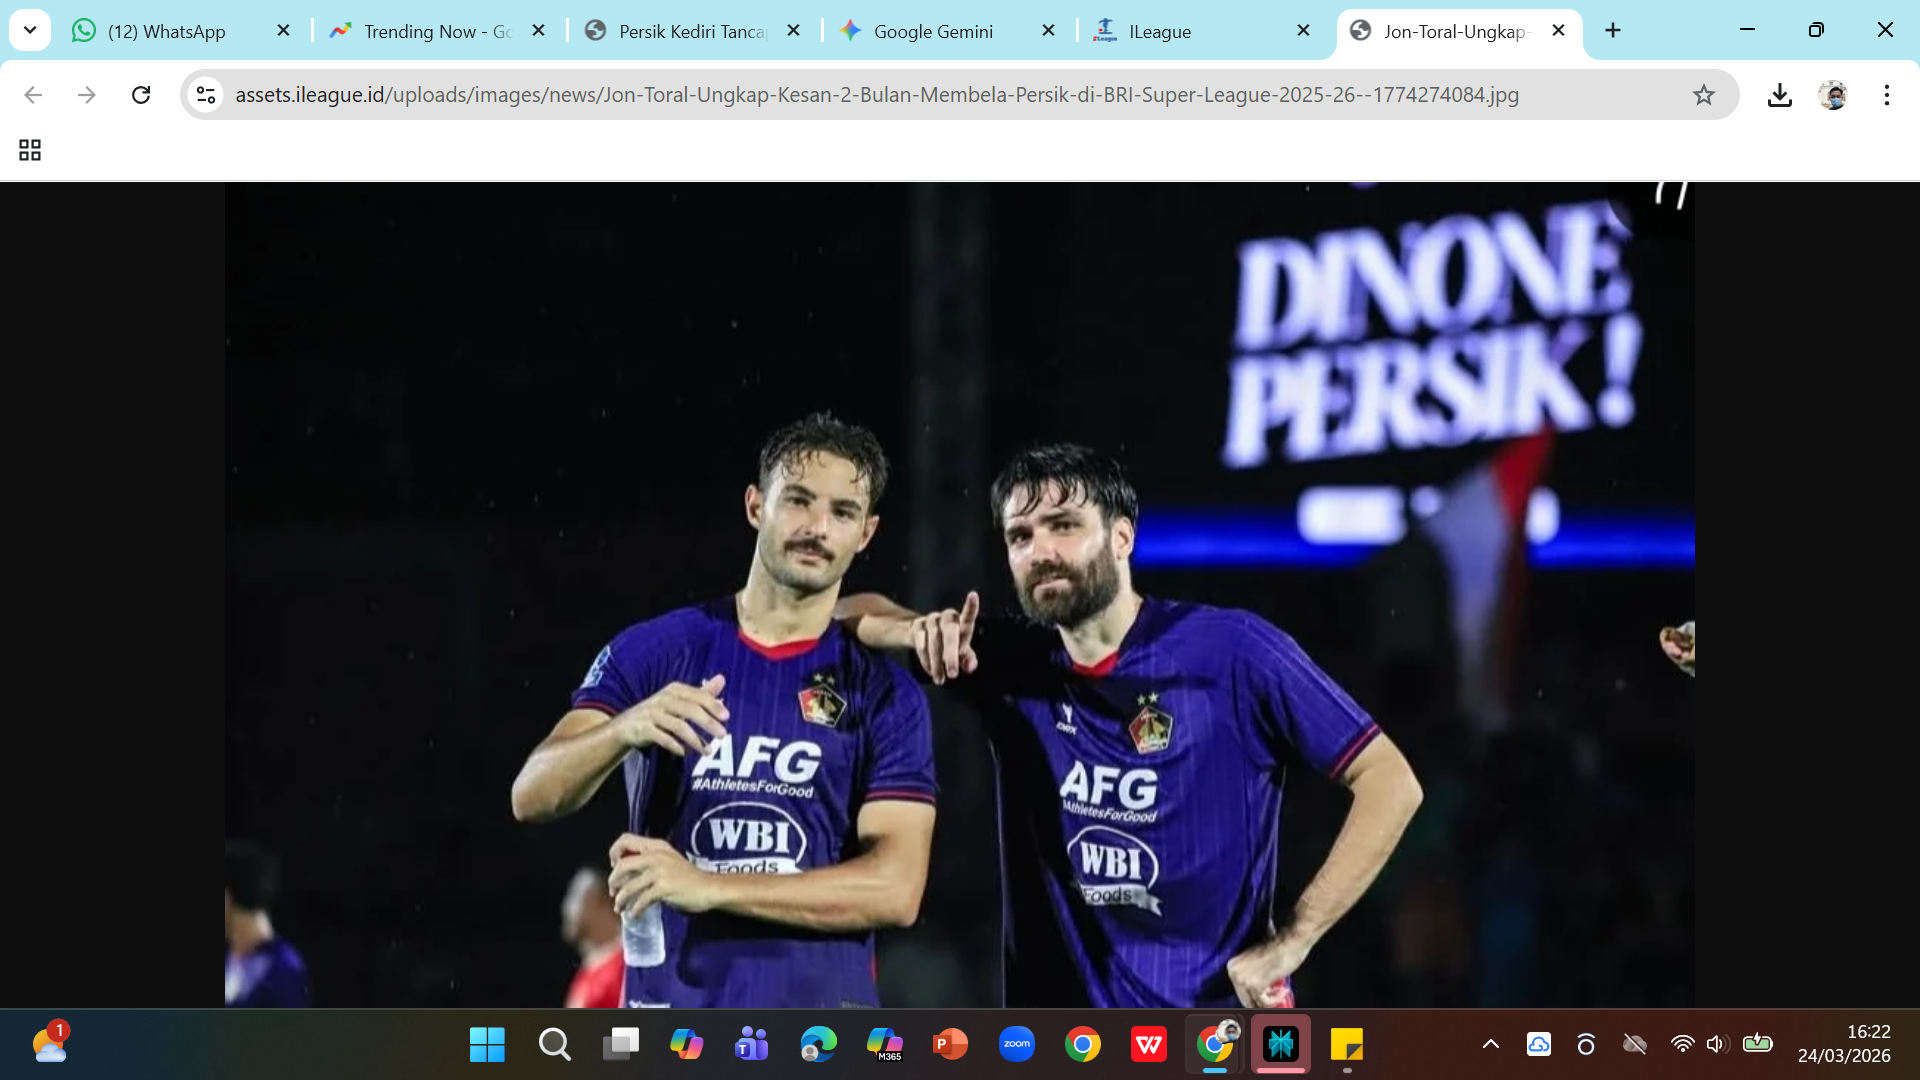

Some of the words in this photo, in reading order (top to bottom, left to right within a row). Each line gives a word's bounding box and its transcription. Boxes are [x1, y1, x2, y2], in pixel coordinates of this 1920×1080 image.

[109, 24, 138, 42] (12)
[142, 24, 226, 43] WhatsApp
[364, 24, 434, 43] Trending
[439, 24, 477, 39] Now
[620, 24, 666, 39] Persik
[671, 24, 715, 39] Kediri
[874, 24, 933, 43] Google
[938, 24, 993, 39] Gemini
[1131, 24, 1192, 43] ILeague
[1384, 24, 1532, 43] Jon-Toral-Ungkap-
[235, 85, 1520, 108] assets.ileague.id/uploads/images/news/Jon-Toral-Ungkap-Kesan-2-Bulan-Membela-Persik-di-BRI-Super-League-2025-26--1774274084.jpg
[1235, 202, 1632, 352] DINONE
[691, 734, 822, 784] AFG
[691, 778, 815, 799] #AthletesForGood
[1059, 760, 1159, 810] AFG
[708, 818, 790, 853] WBI
[1080, 841, 1142, 880] WBI
[56, 1023, 63, 1037] 1
[1848, 1024, 1892, 1039] 16:22
[1003, 1039, 1031, 1048] zoom
[878, 1052, 902, 1061] M365
[1798, 1048, 1892, 1065] 24/03/2026
